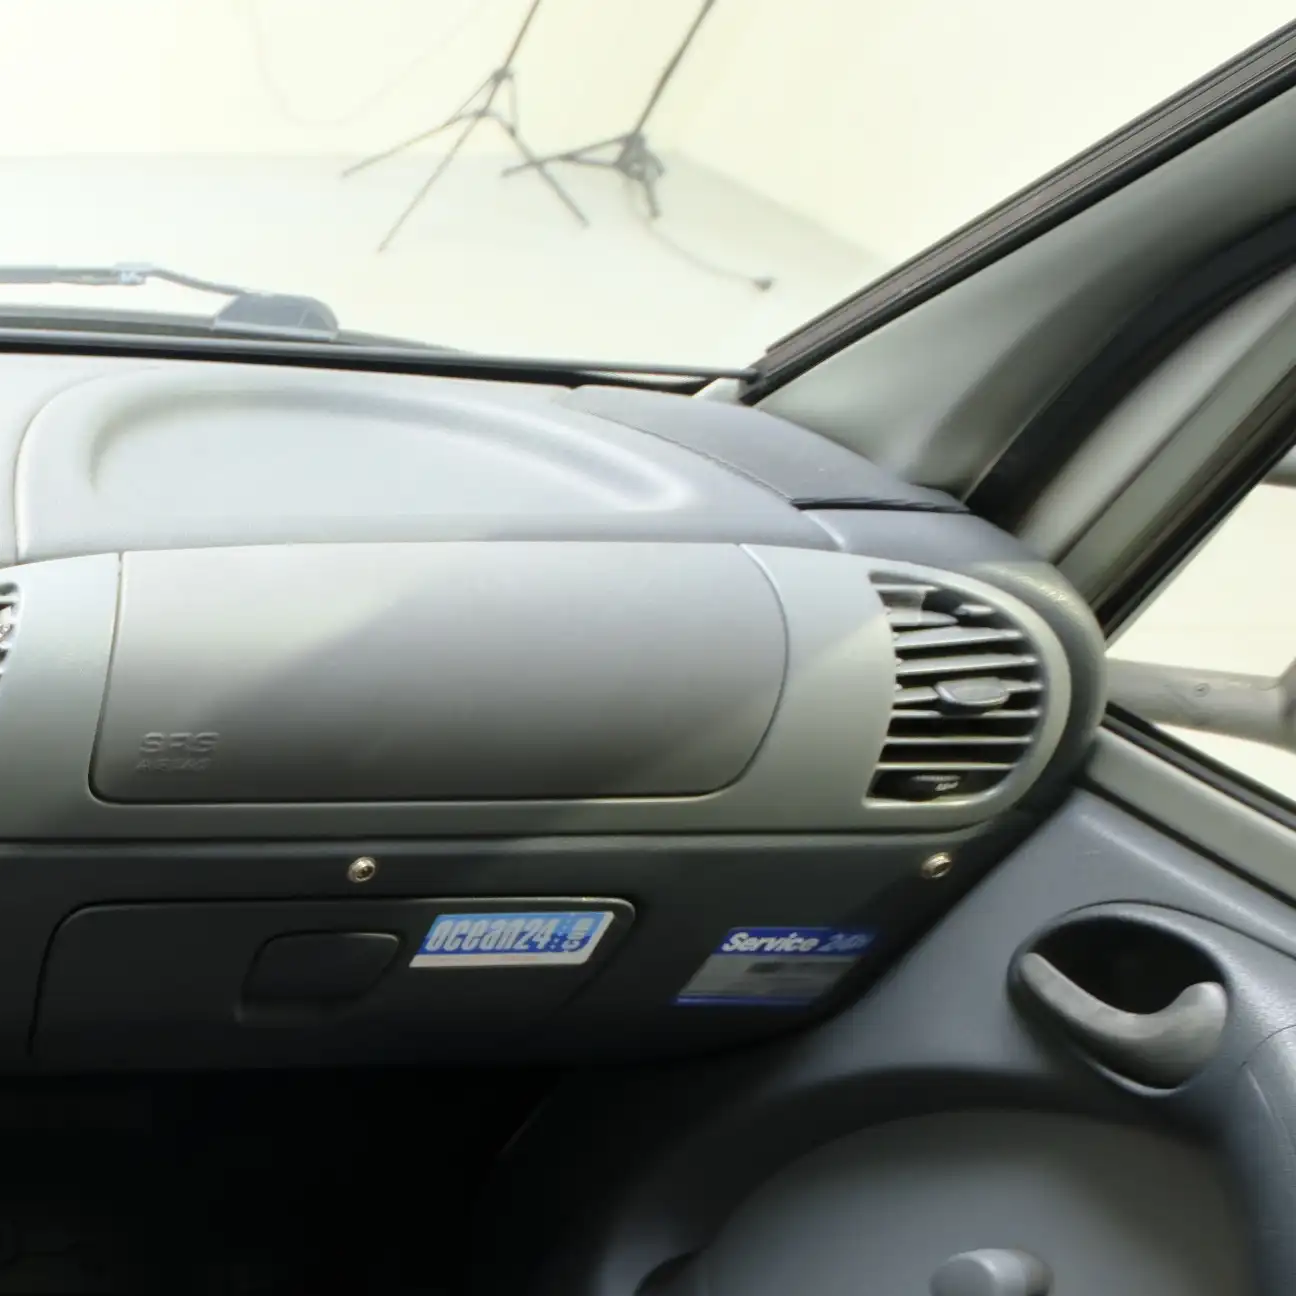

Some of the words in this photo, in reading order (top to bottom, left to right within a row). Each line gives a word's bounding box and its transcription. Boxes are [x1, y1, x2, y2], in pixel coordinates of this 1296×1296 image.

[140, 731, 220, 753] SRS
[425, 917, 558, 952] ocean24
[721, 931, 821, 952] Service
